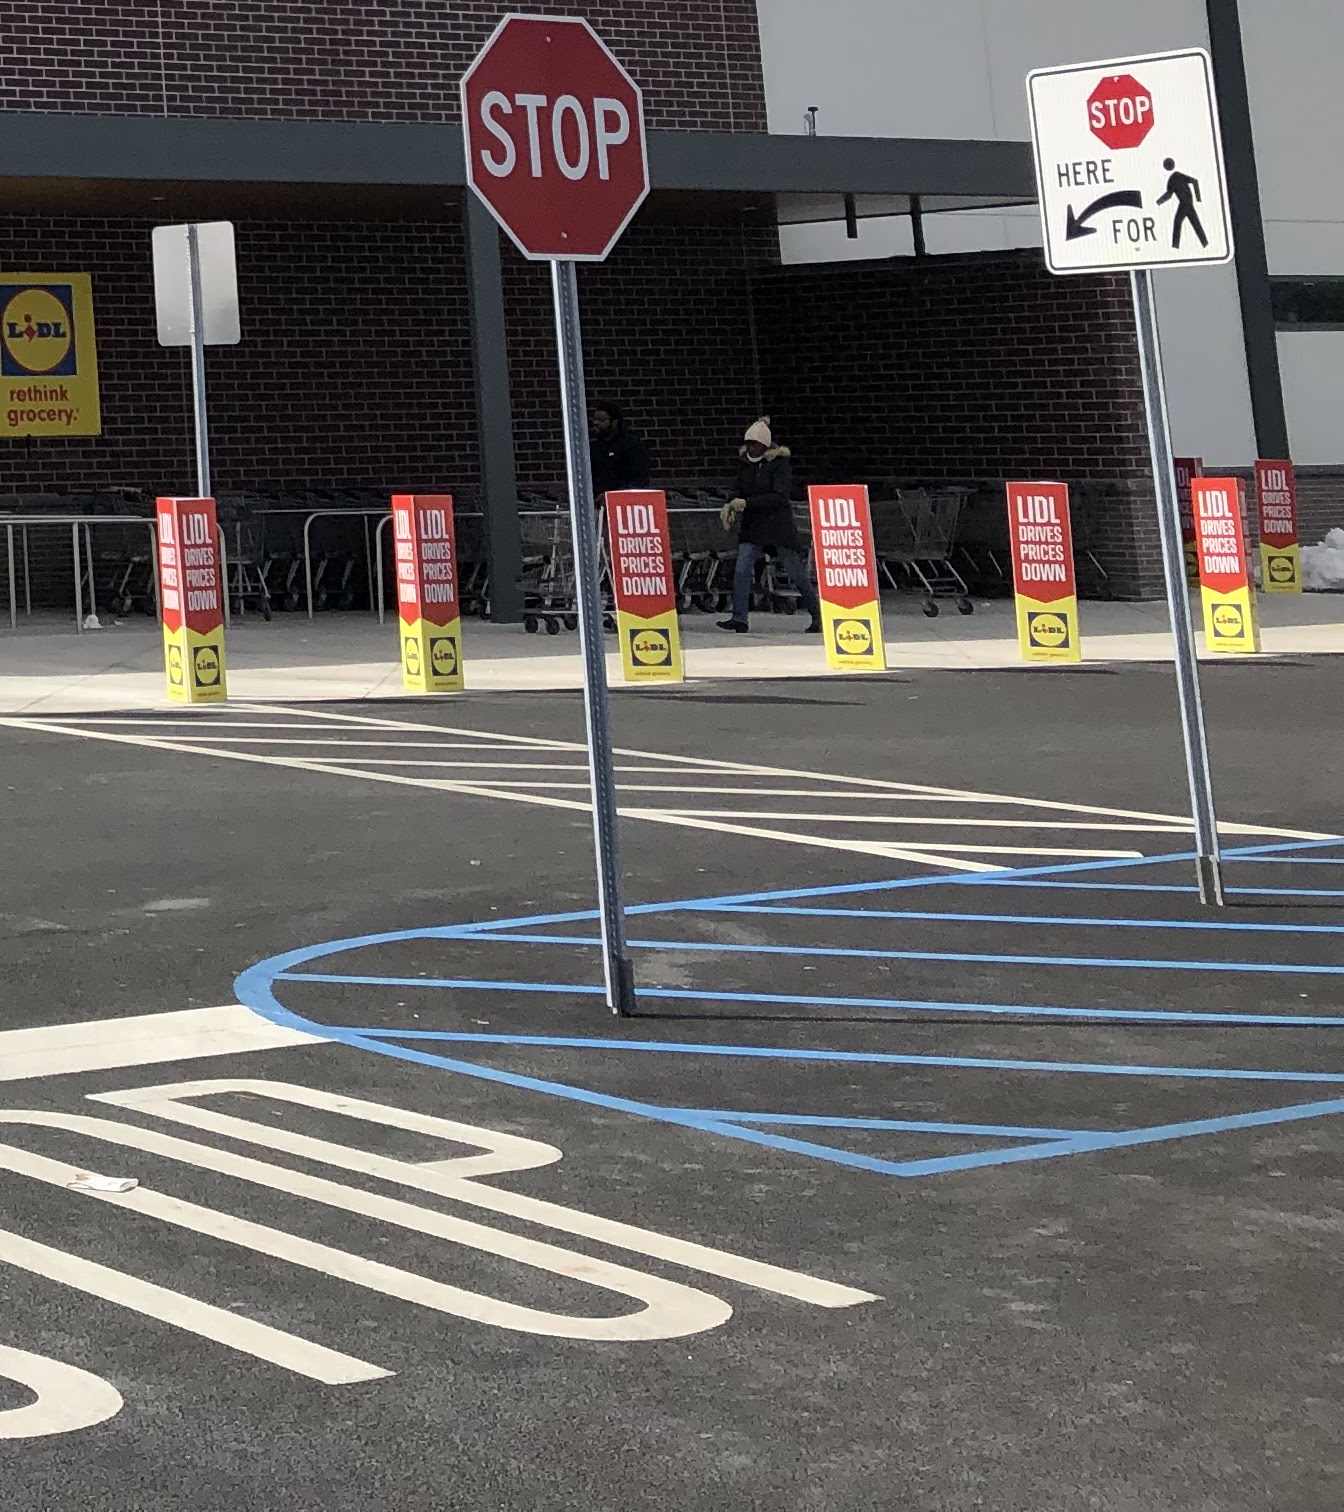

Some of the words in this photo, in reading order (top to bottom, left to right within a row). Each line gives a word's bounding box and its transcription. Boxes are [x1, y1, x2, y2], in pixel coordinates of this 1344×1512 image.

[1091, 96, 1150, 129] STOP
[480, 90, 630, 181] STOP
[1057, 159, 1115, 188] HERE
[1112, 217, 1157, 244] FOR
[10, 384, 69, 402] rethink
[1260, 469, 1289, 491] LIDL
[818, 498, 861, 527] LIDL
[1016, 495, 1060, 523] LIDL
[1197, 490, 1232, 518] LIDL
[182, 513, 212, 545] LIDL
[419, 510, 449, 539] LIDL
[616, 505, 660, 535] LIDL
[1200, 519, 1235, 536] DRIVES
[821, 529, 863, 547] DRIVES
[1018, 525, 1062, 542] DRIVES
[421, 542, 451, 560] DRIVES
[618, 536, 662, 554] DRIVES
[1020, 544, 1064, 561] PRICES
[1202, 537, 1237, 554] PRICES
[184, 548, 214, 567] DRIVES
[620, 556, 664, 574] PRICES
[823, 548, 866, 566] PRICES
[1204, 555, 1240, 574] DOWN
[186, 568, 216, 588] PRICES
[423, 562, 452, 581] PRICES
[825, 568, 868, 587] DOWN
[1021, 563, 1067, 582] DOWN
[424, 583, 454, 603] DOWN
[622, 576, 667, 596] DOWN
[188, 590, 217, 611] DOWN
